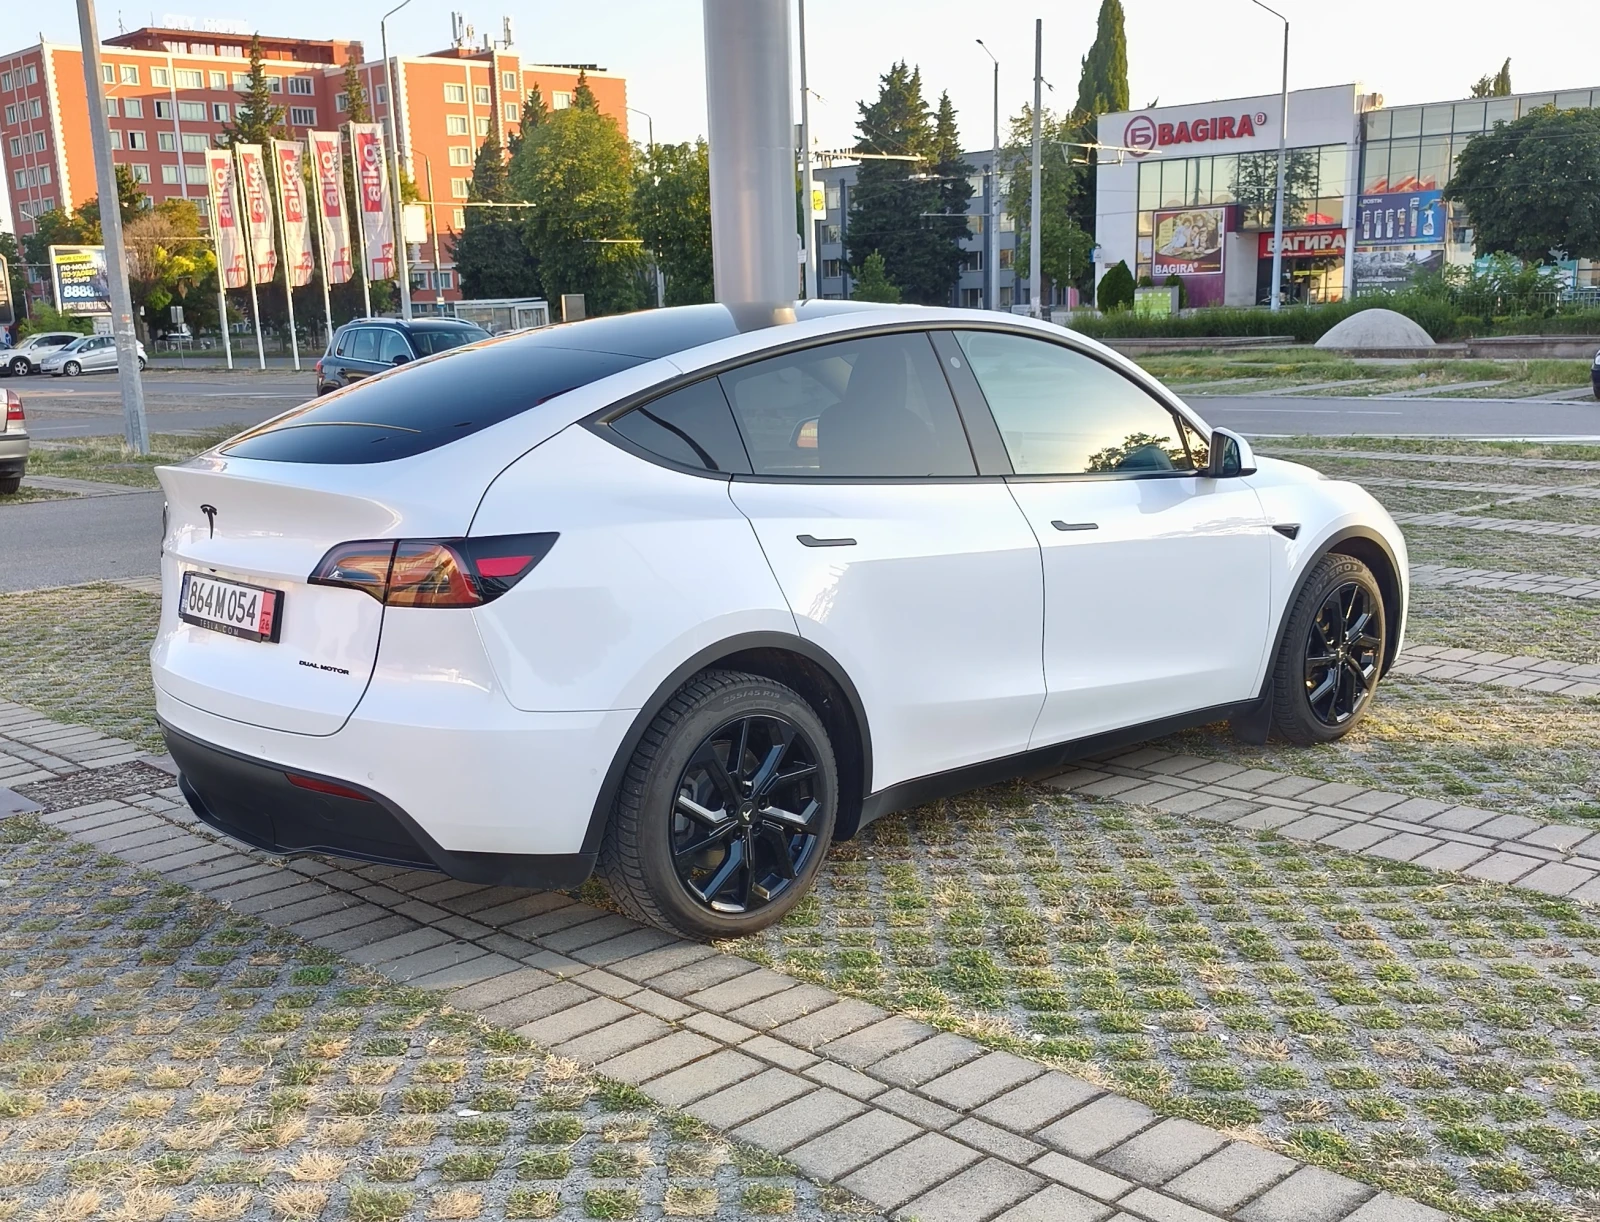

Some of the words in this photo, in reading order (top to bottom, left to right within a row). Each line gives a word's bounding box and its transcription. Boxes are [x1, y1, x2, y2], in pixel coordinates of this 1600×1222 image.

[1158, 114, 1255, 146] BAGIRA
[248, 162, 264, 214] aiko
[283, 160, 301, 213] aiko
[321, 151, 339, 207] aiko
[363, 143, 381, 202] aiko
[215, 168, 231, 219] aiko
[200, 619, 239, 636] TESLA.COM
[260, 618, 270, 631] 26
[299, 660, 319, 669] DUAL
[320, 664, 349, 675] MOTOR
[722, 689, 761, 705] 255/45
[762, 690, 781, 699] R19
